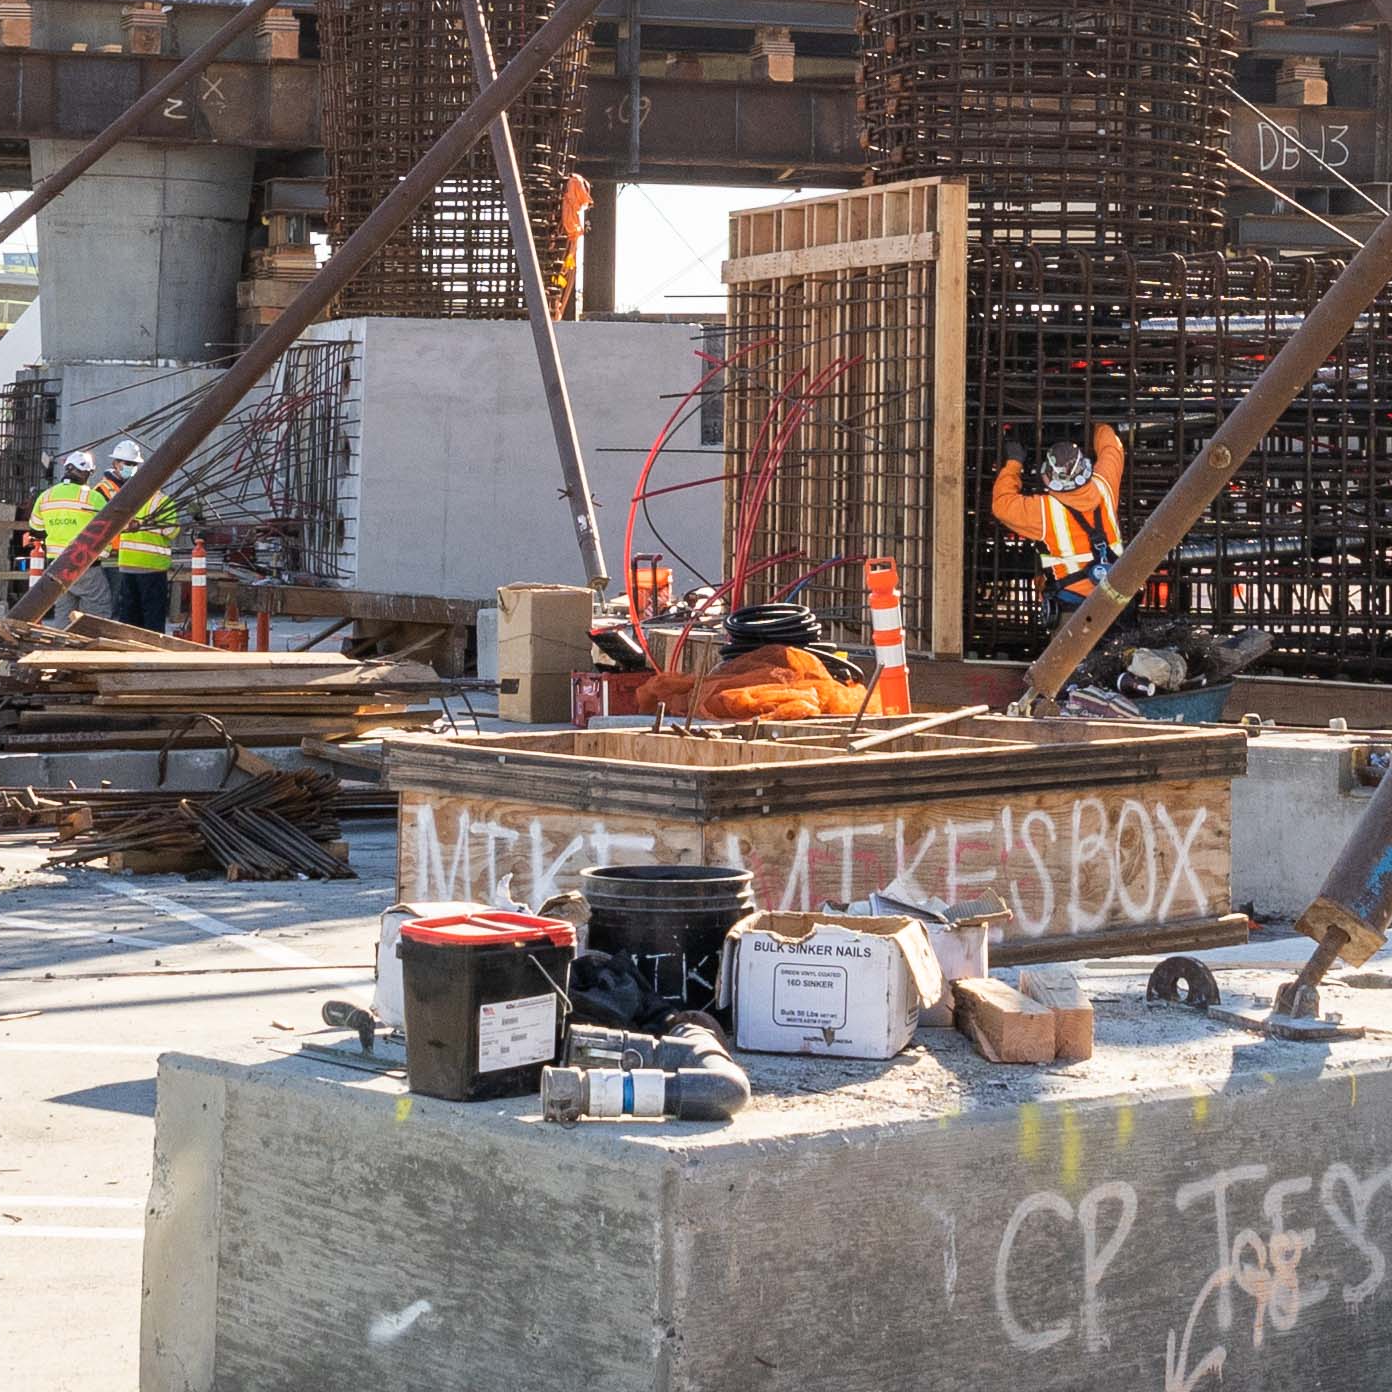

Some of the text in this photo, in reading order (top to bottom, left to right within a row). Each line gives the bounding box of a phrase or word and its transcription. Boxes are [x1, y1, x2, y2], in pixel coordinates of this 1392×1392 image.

[1257, 121, 1349, 172] DB-13
[753, 941, 872, 958] BULK SINKER NAILS
[802, 979, 834, 989] SINKER
[994, 1179, 1140, 1354] CP
